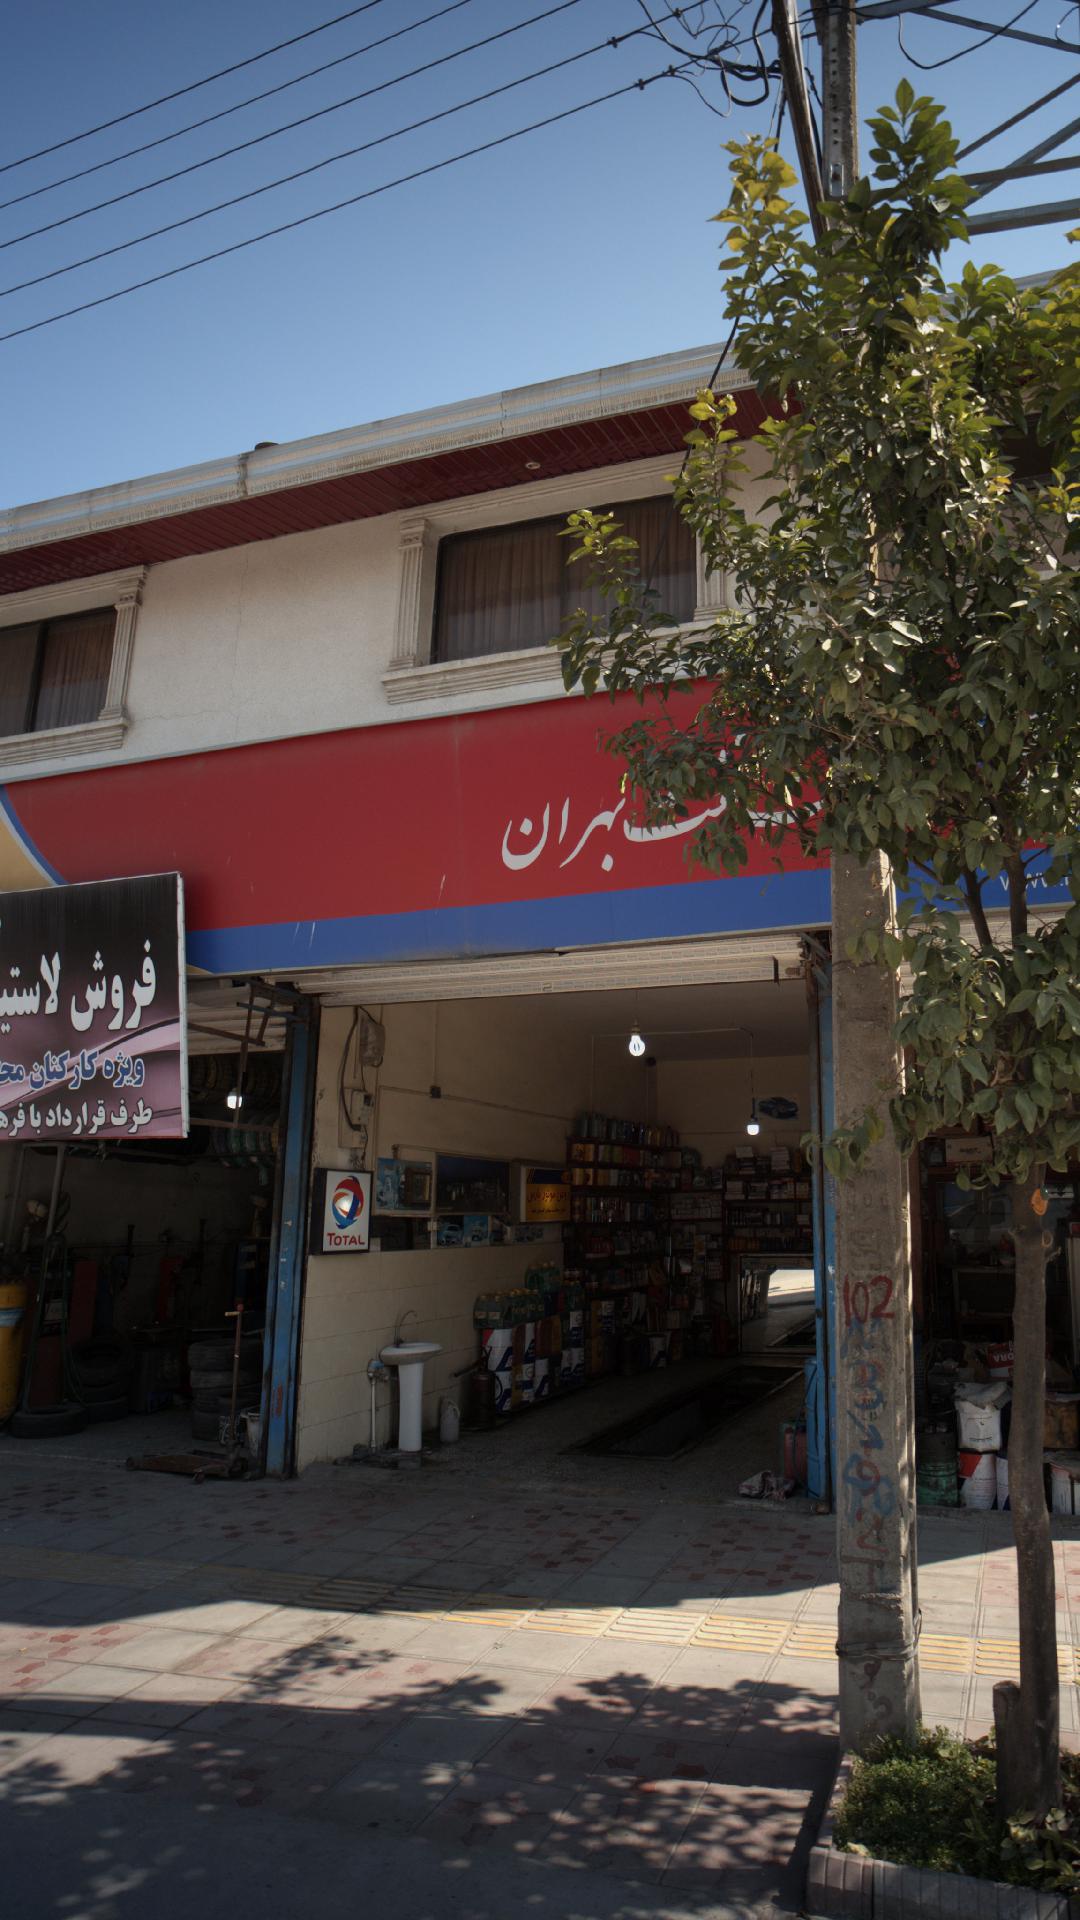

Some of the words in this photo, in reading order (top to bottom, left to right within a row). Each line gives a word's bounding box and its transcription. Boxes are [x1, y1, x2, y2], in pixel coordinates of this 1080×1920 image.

[501, 796, 626, 872] بهران
[0, 950, 61, 1035] لاستی
[70, 939, 157, 1032] فروش
[101, 1051, 146, 1088] ویژه
[0, 1102, 26, 1137] فره
[29, 1103, 42, 1134] با
[46, 1100, 107, 1135] قرارداد
[110, 1098, 153, 1134] طرف
[326, 1231, 365, 1247] TOTAL
[842, 1274, 895, 1327] 102
